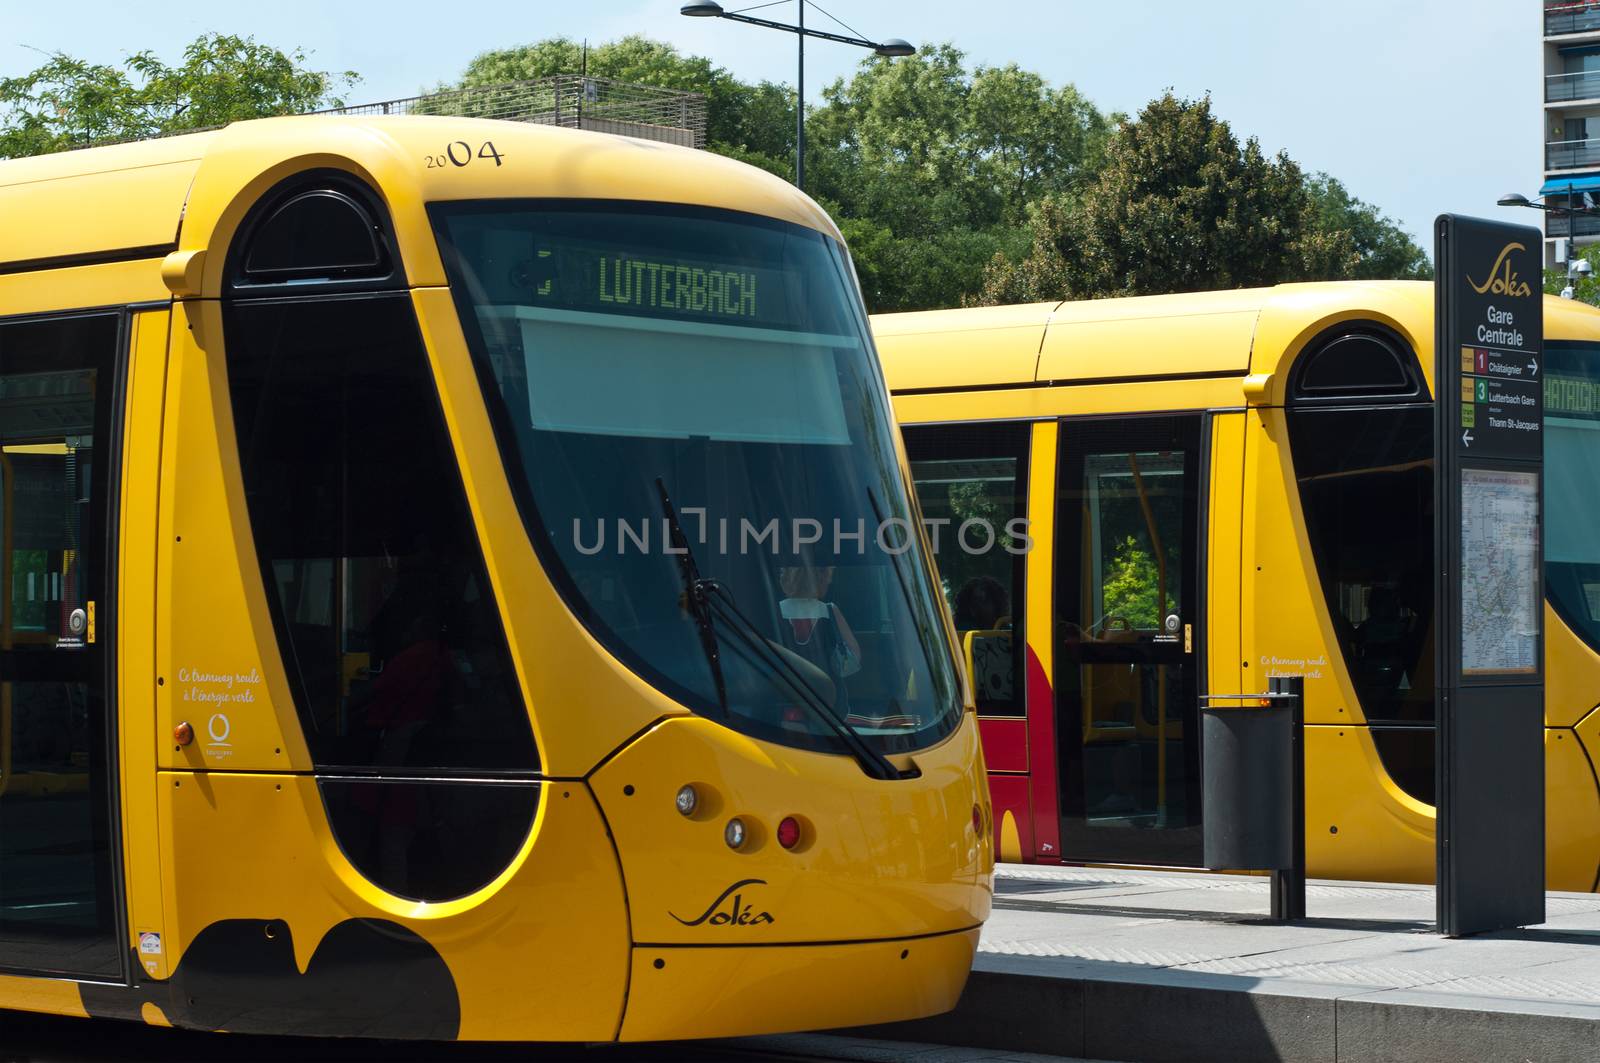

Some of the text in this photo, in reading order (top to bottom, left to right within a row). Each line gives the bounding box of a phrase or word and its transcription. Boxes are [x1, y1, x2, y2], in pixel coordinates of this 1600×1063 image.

[1466, 242, 1531, 297] Soléa
[600, 257, 756, 317] LUTTERBACH
[1487, 305, 1513, 325] Gare
[1477, 324, 1523, 346] Centrale
[1479, 353, 1484, 369] 1
[1478, 382, 1485, 400] 3
[1488, 392, 1535, 406] Lutterbach Gare
[1488, 416, 1507, 428] Thann
[178, 667, 260, 688] Ce tramway roule
[231, 689, 255, 702] verte
[668, 878, 775, 926] Soléa
